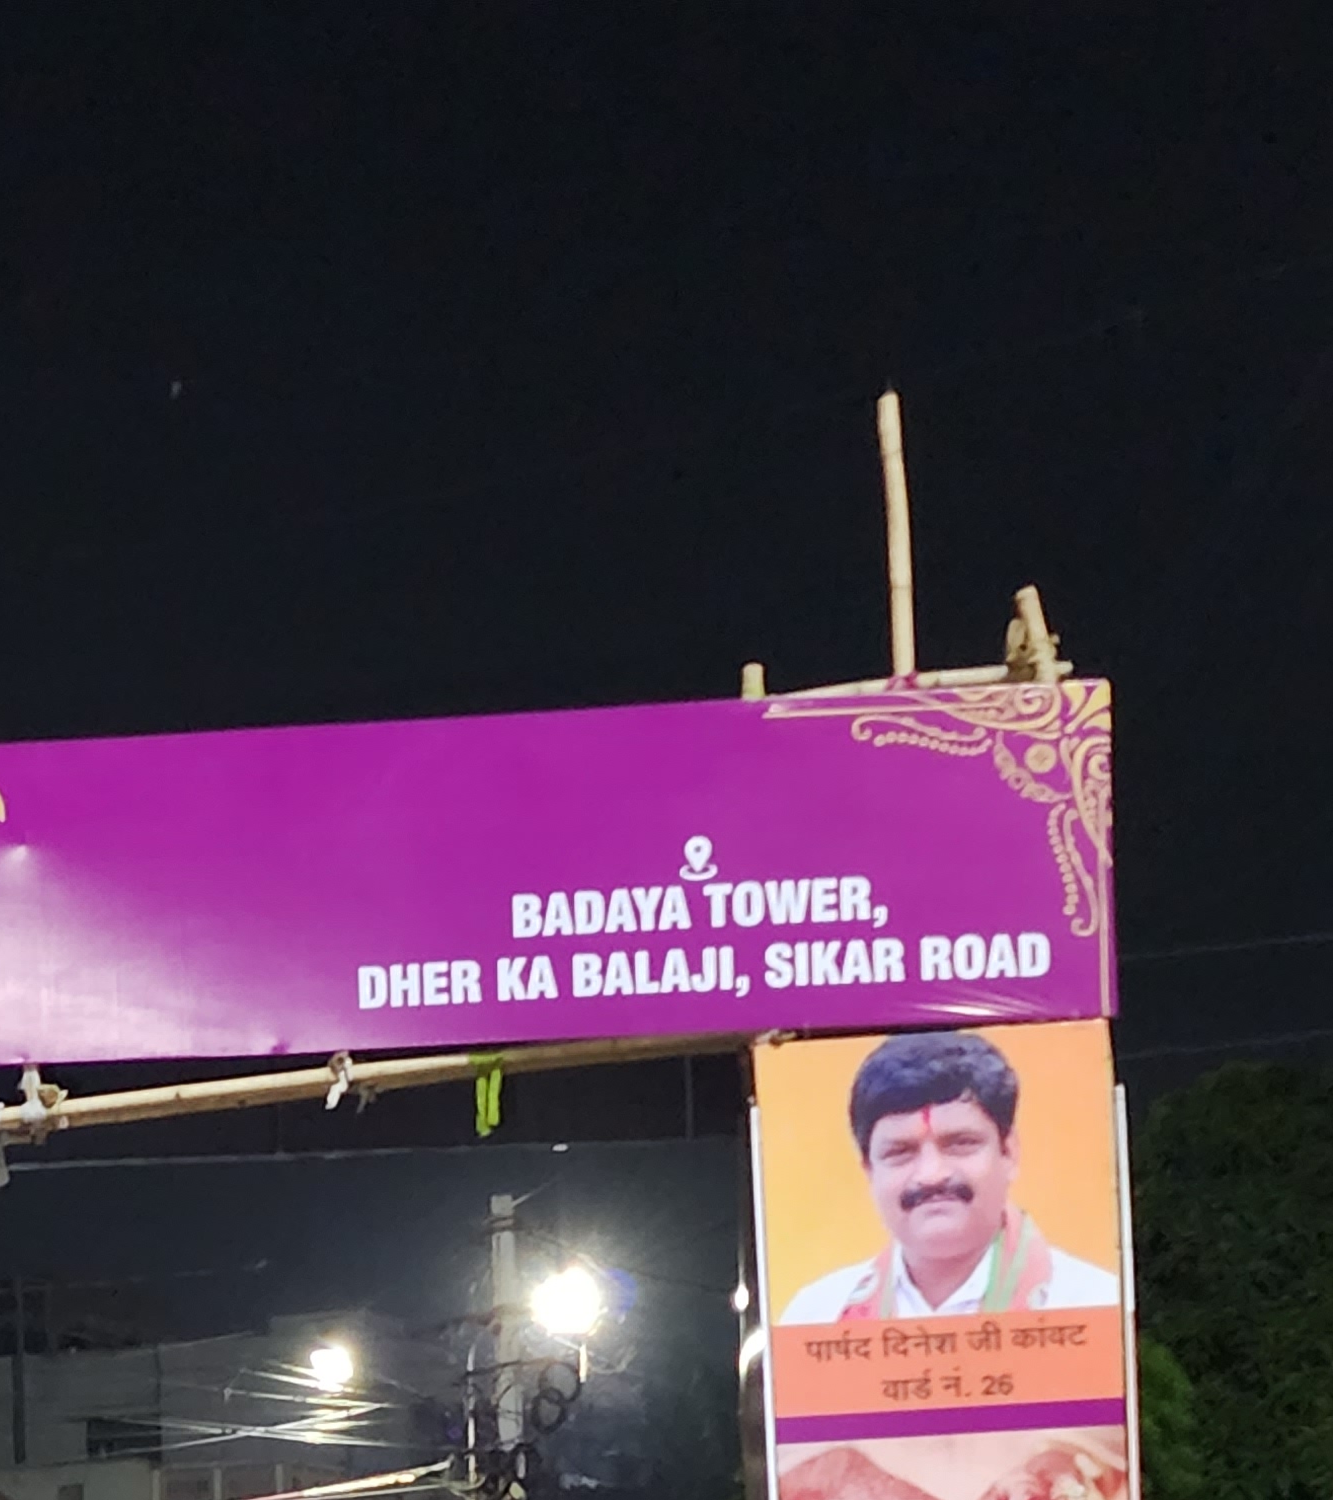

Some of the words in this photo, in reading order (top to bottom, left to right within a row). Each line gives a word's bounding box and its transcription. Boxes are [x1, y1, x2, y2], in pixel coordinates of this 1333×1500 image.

[511, 884, 693, 939] BADAYA
[704, 876, 889, 929] TOWER,
[357, 959, 483, 1011] DHER
[496, 955, 559, 1002] KA
[571, 945, 751, 998] BALAJI,
[764, 937, 906, 989] SIKAR
[919, 931, 1051, 982] ROAD
[881, 1323, 958, 1358] दिनेश
[964, 1319, 1003, 1352] जी
[880, 1368, 933, 1401] वार्ड
[980, 1372, 1015, 1397] 26
